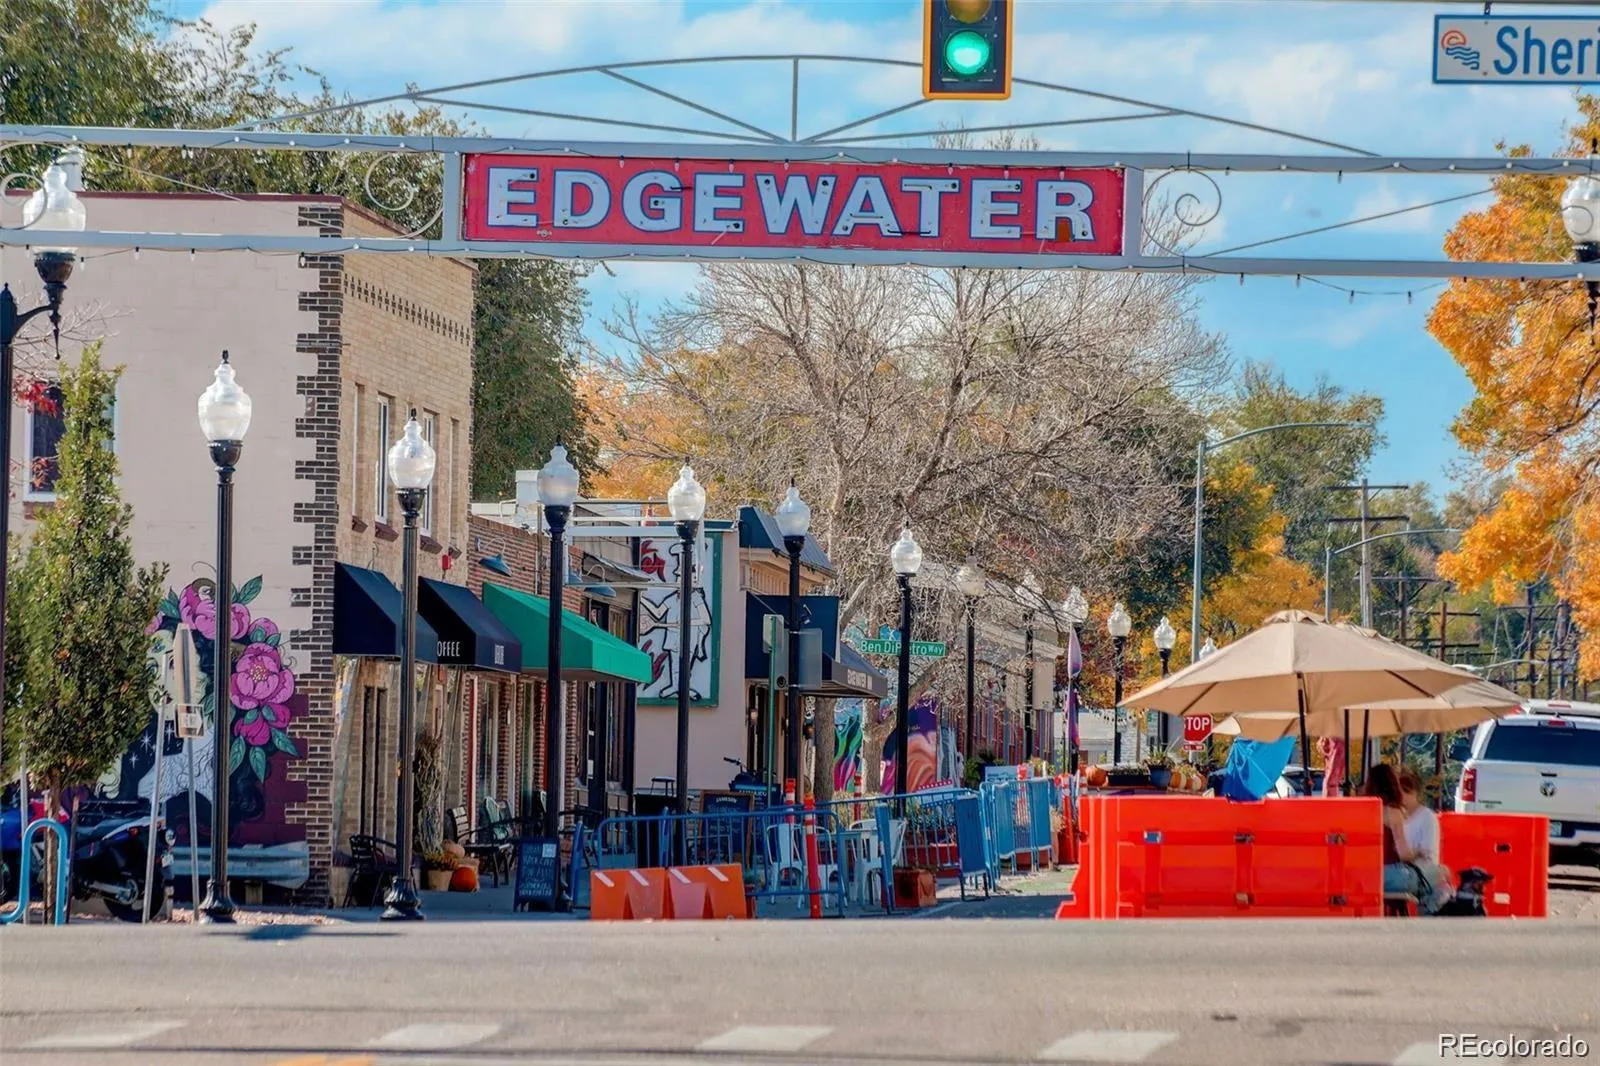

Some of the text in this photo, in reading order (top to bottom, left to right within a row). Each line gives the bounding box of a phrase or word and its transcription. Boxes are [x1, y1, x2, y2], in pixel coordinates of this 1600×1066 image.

[486, 166, 1096, 241] EDGEWATER
[436, 640, 460, 657] OFFEE
[860, 640, 881, 653] Ben
[884, 641, 927, 656] DiPtro
